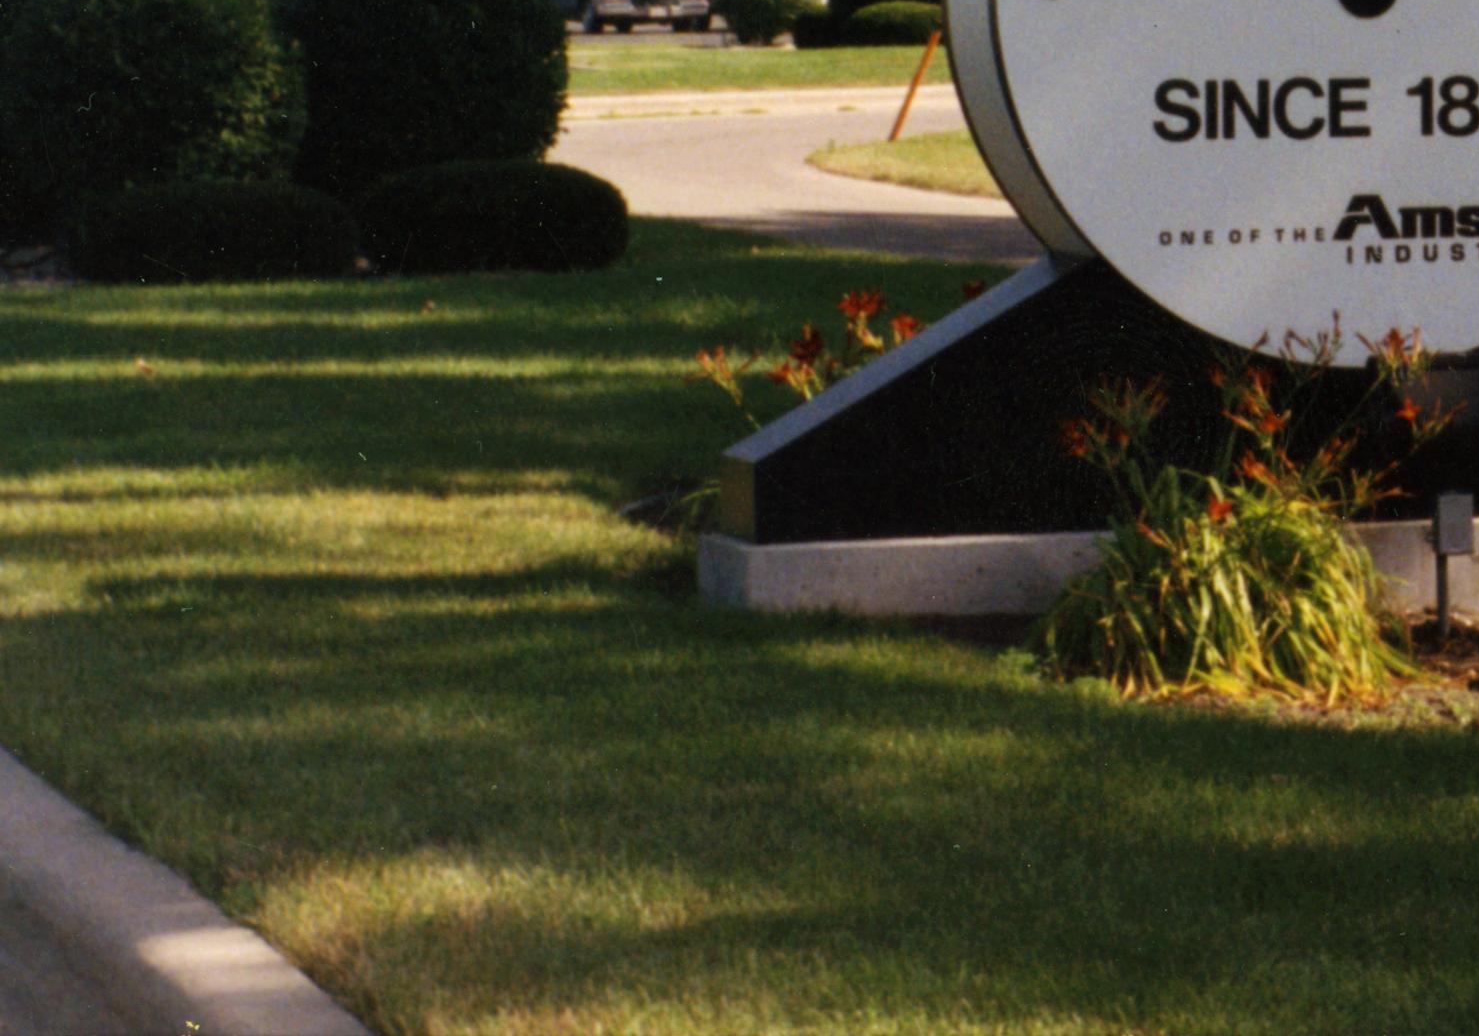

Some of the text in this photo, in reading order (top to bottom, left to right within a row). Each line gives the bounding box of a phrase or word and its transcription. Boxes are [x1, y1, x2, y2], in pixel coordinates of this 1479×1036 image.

[1152, 76, 1372, 143] SINCE
[1158, 229, 1215, 247] ONE
[1228, 227, 1262, 245] OF
[1274, 226, 1326, 244] THE
